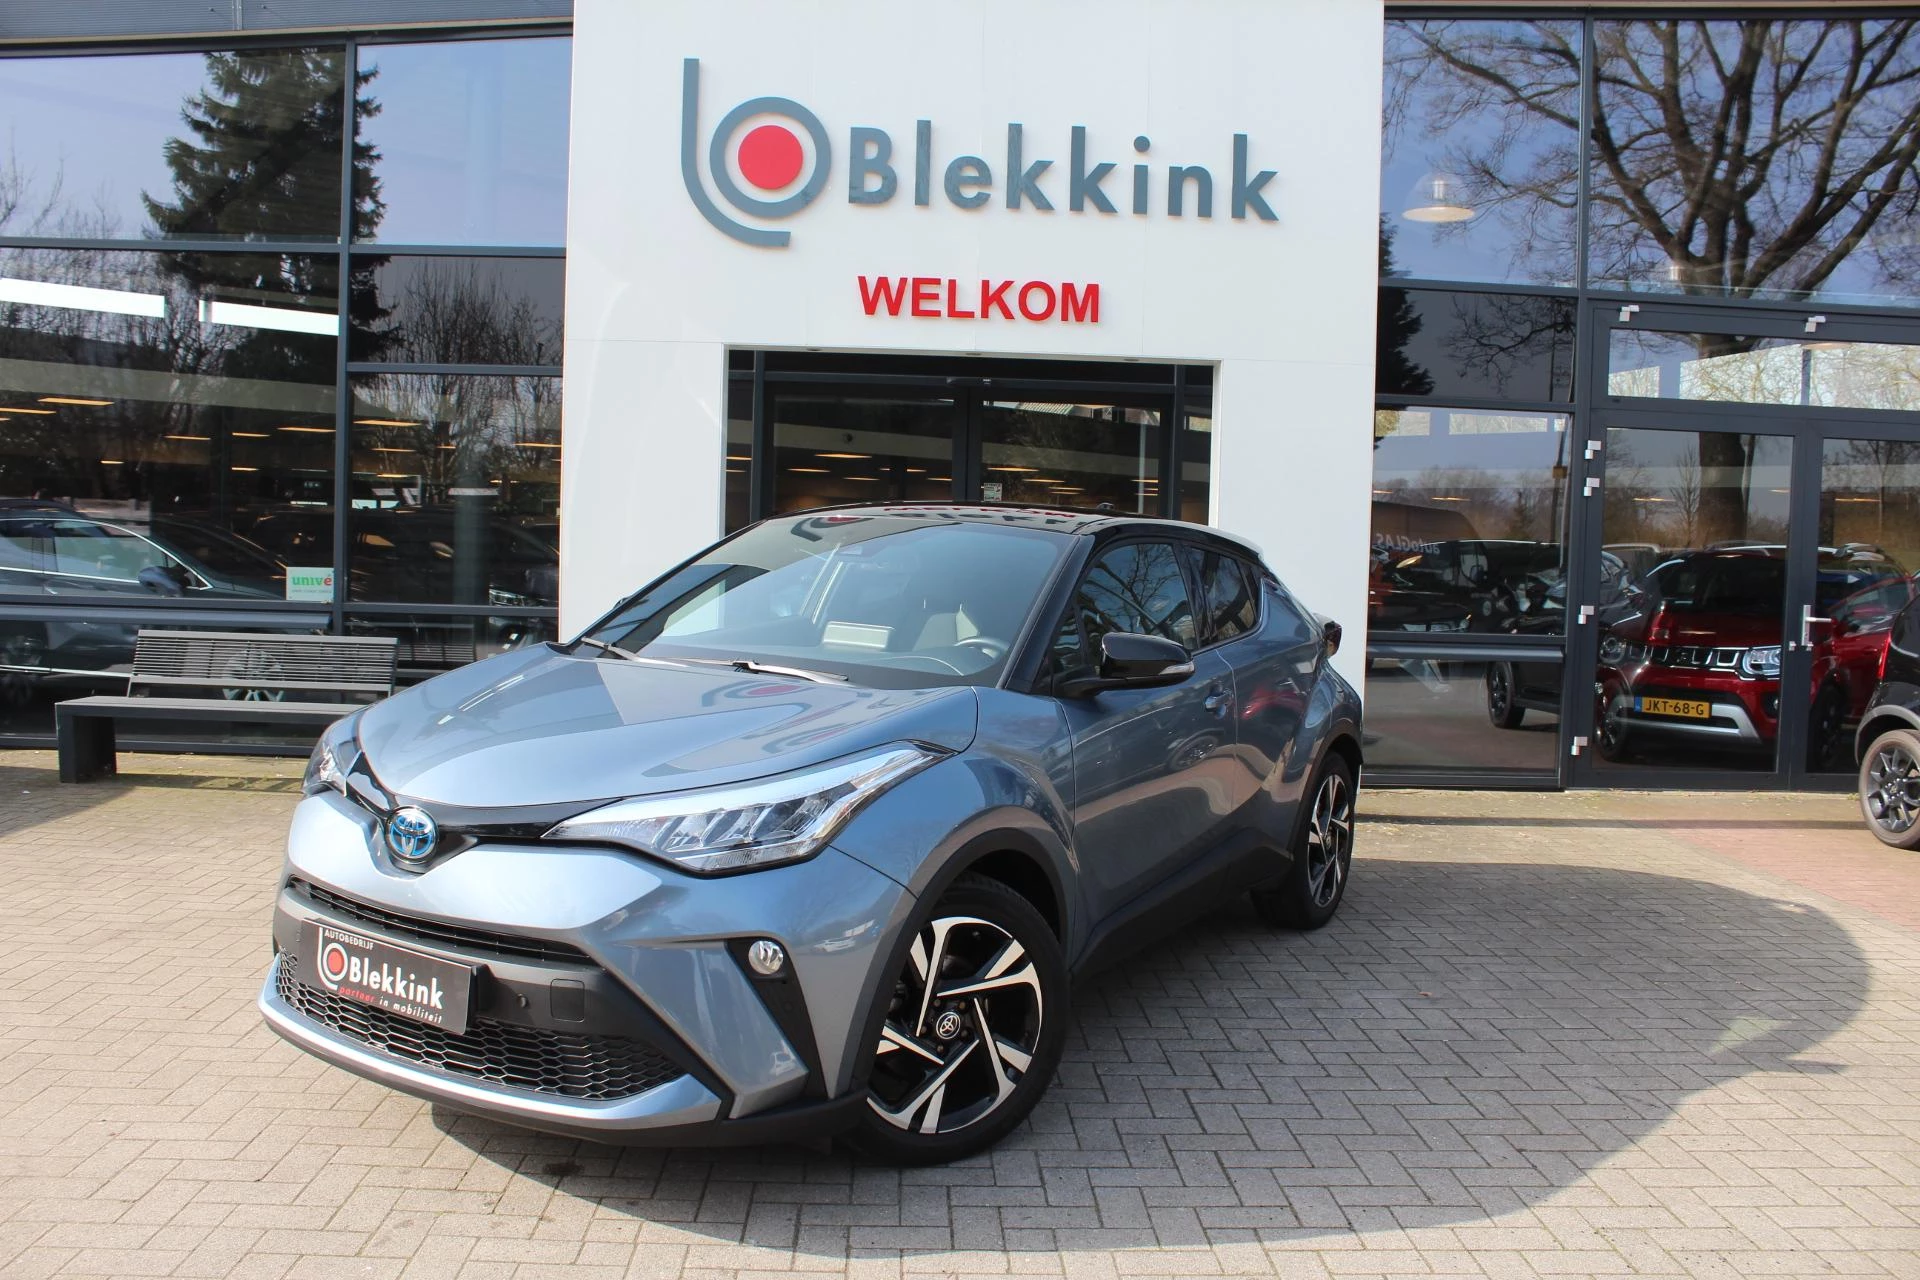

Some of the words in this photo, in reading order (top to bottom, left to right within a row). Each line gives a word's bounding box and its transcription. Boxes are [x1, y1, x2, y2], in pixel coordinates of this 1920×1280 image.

[848, 119, 1280, 222] Blekkink
[858, 275, 1100, 324] WELKOM
[1646, 700, 1705, 715] JKT-68-G
[324, 928, 374, 951] AUTOBEDRIJF
[349, 956, 444, 1010] Blekkink
[338, 986, 375, 1003] partner
[379, 996, 389, 1007] in
[393, 1002, 443, 1024] mobiliteit
